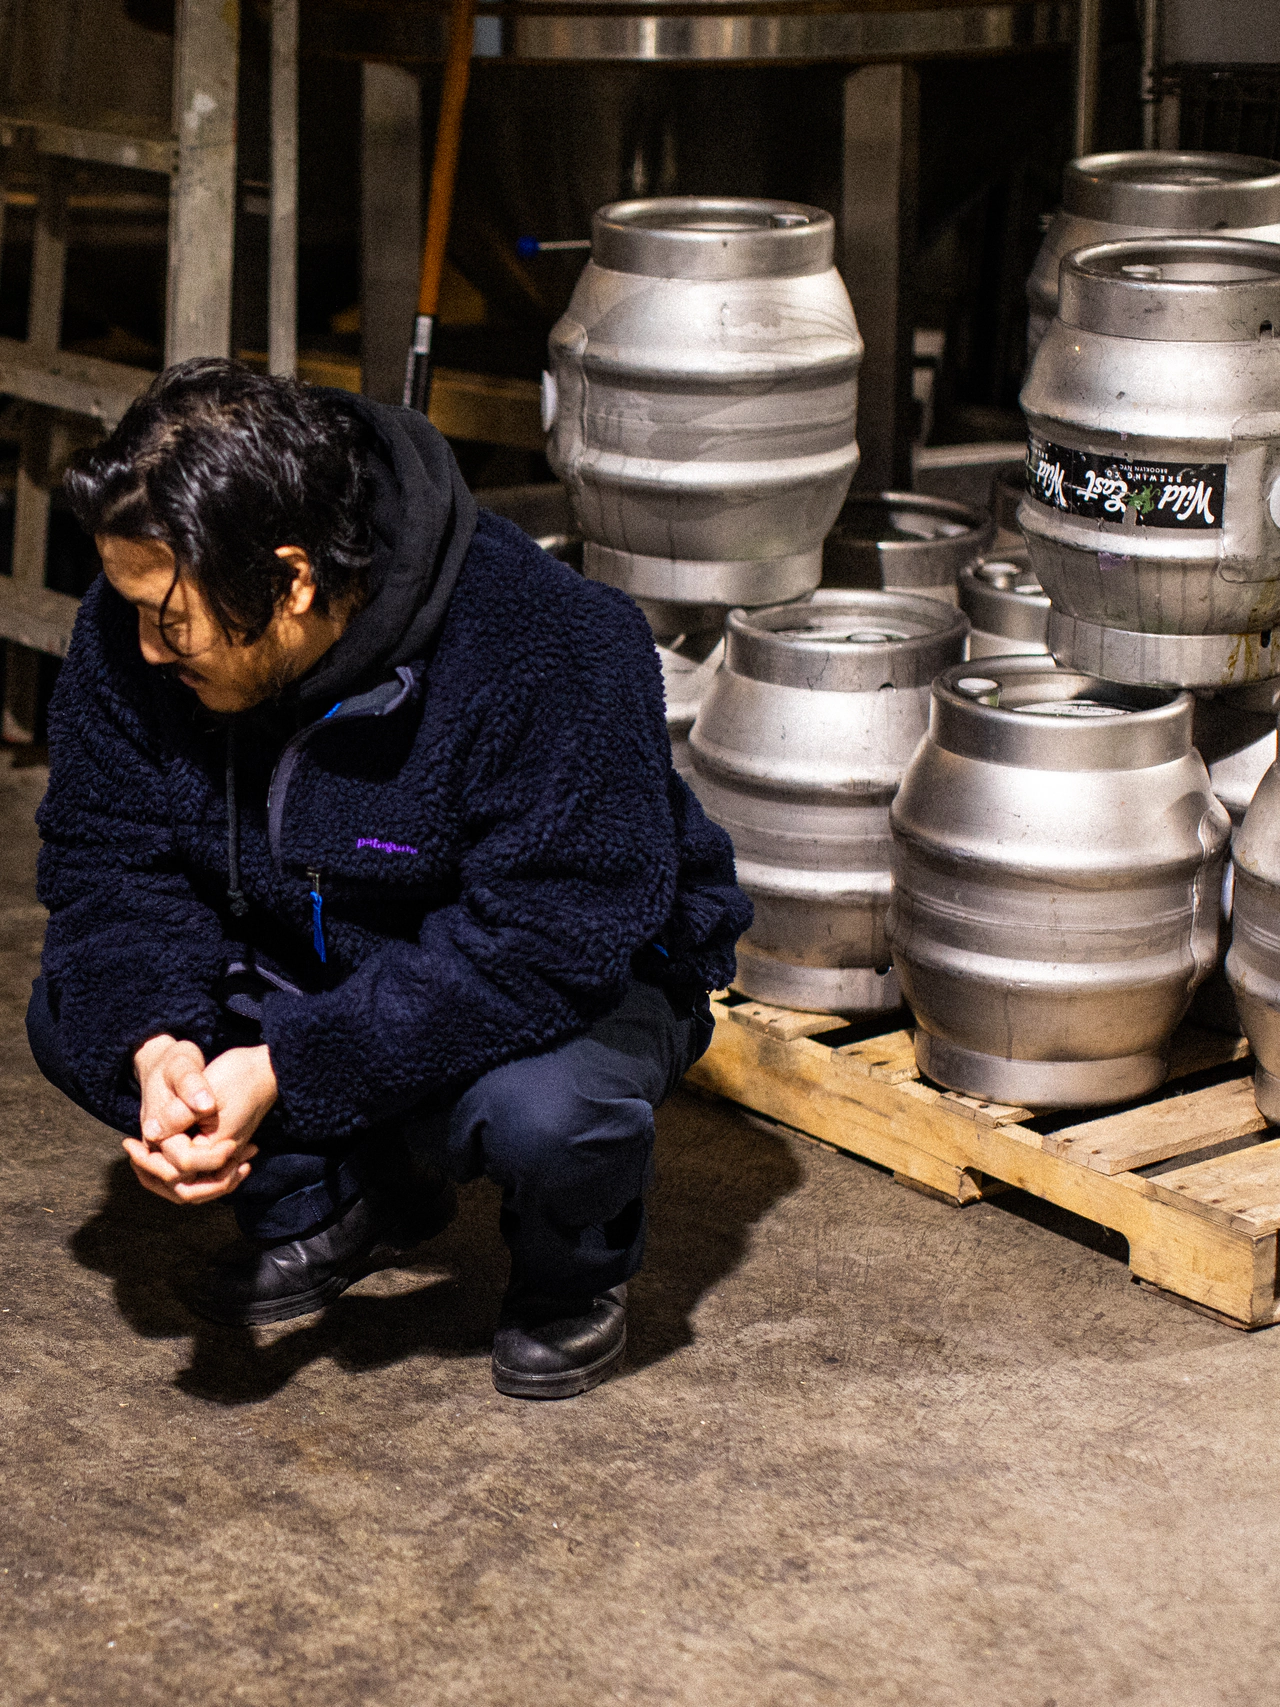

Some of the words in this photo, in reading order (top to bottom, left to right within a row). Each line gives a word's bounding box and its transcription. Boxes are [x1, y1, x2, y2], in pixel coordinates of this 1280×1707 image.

[1076, 469, 1129, 513] East
[1126, 471, 1182, 483] BREWING
[1158, 480, 1215, 524] Wild
